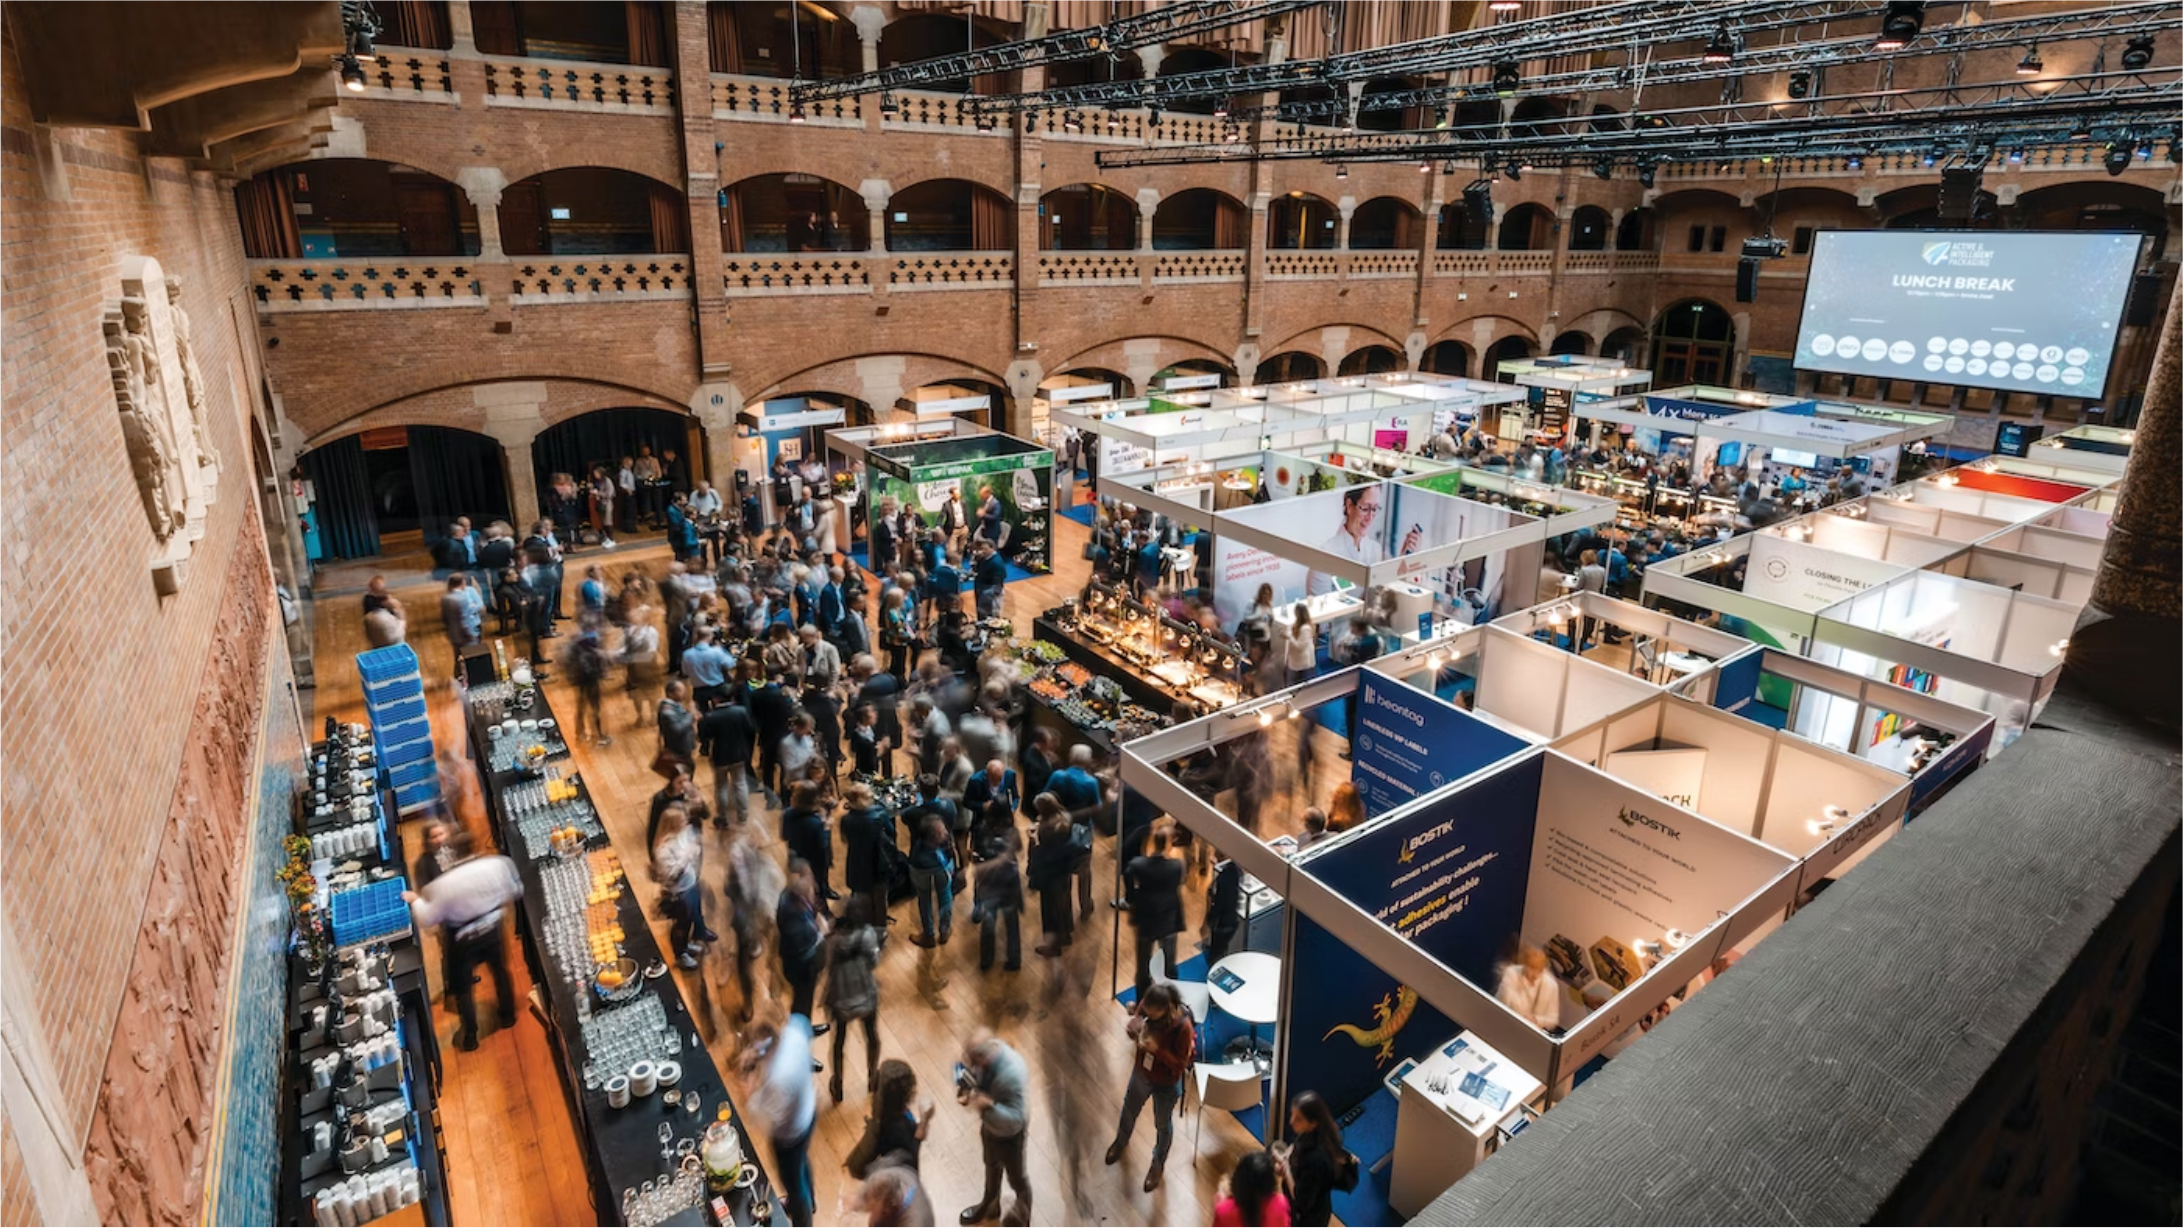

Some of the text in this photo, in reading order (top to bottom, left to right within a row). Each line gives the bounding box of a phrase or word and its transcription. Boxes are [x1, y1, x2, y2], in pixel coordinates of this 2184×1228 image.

[1949, 250, 1994, 260] INTELLIGENT
[1950, 242, 1977, 251] ACTIVE
[1948, 258, 1990, 267] PACKAGING
[1893, 274, 2016, 292] LUNCH BREAK
[1226, 551, 1246, 561] Avery
[1226, 558, 1261, 572] pioneering
[1225, 571, 1245, 581] labels
[1247, 567, 1263, 577] since
[1804, 567, 1842, 583] CLOSING
[1844, 577, 1860, 589] THE
[1377, 694, 1424, 728] beontag
[1404, 738, 1429, 756] LABELS
[1409, 818, 1454, 851] BOSTIK
[1630, 810, 1681, 841] BOSTIK
[1609, 828, 1696, 873] ATTACHED TO YOUR WORLD
[1390, 844, 1467, 889] ATTACHED TO YOUR WORLD
[1389, 900, 1399, 914] of
[1400, 874, 1453, 908] sustainability
[1600, 881, 1617, 895] labels
[1398, 894, 1447, 929] adhesives
[1448, 876, 1480, 901] enable
[1415, 898, 1464, 937] packaging
